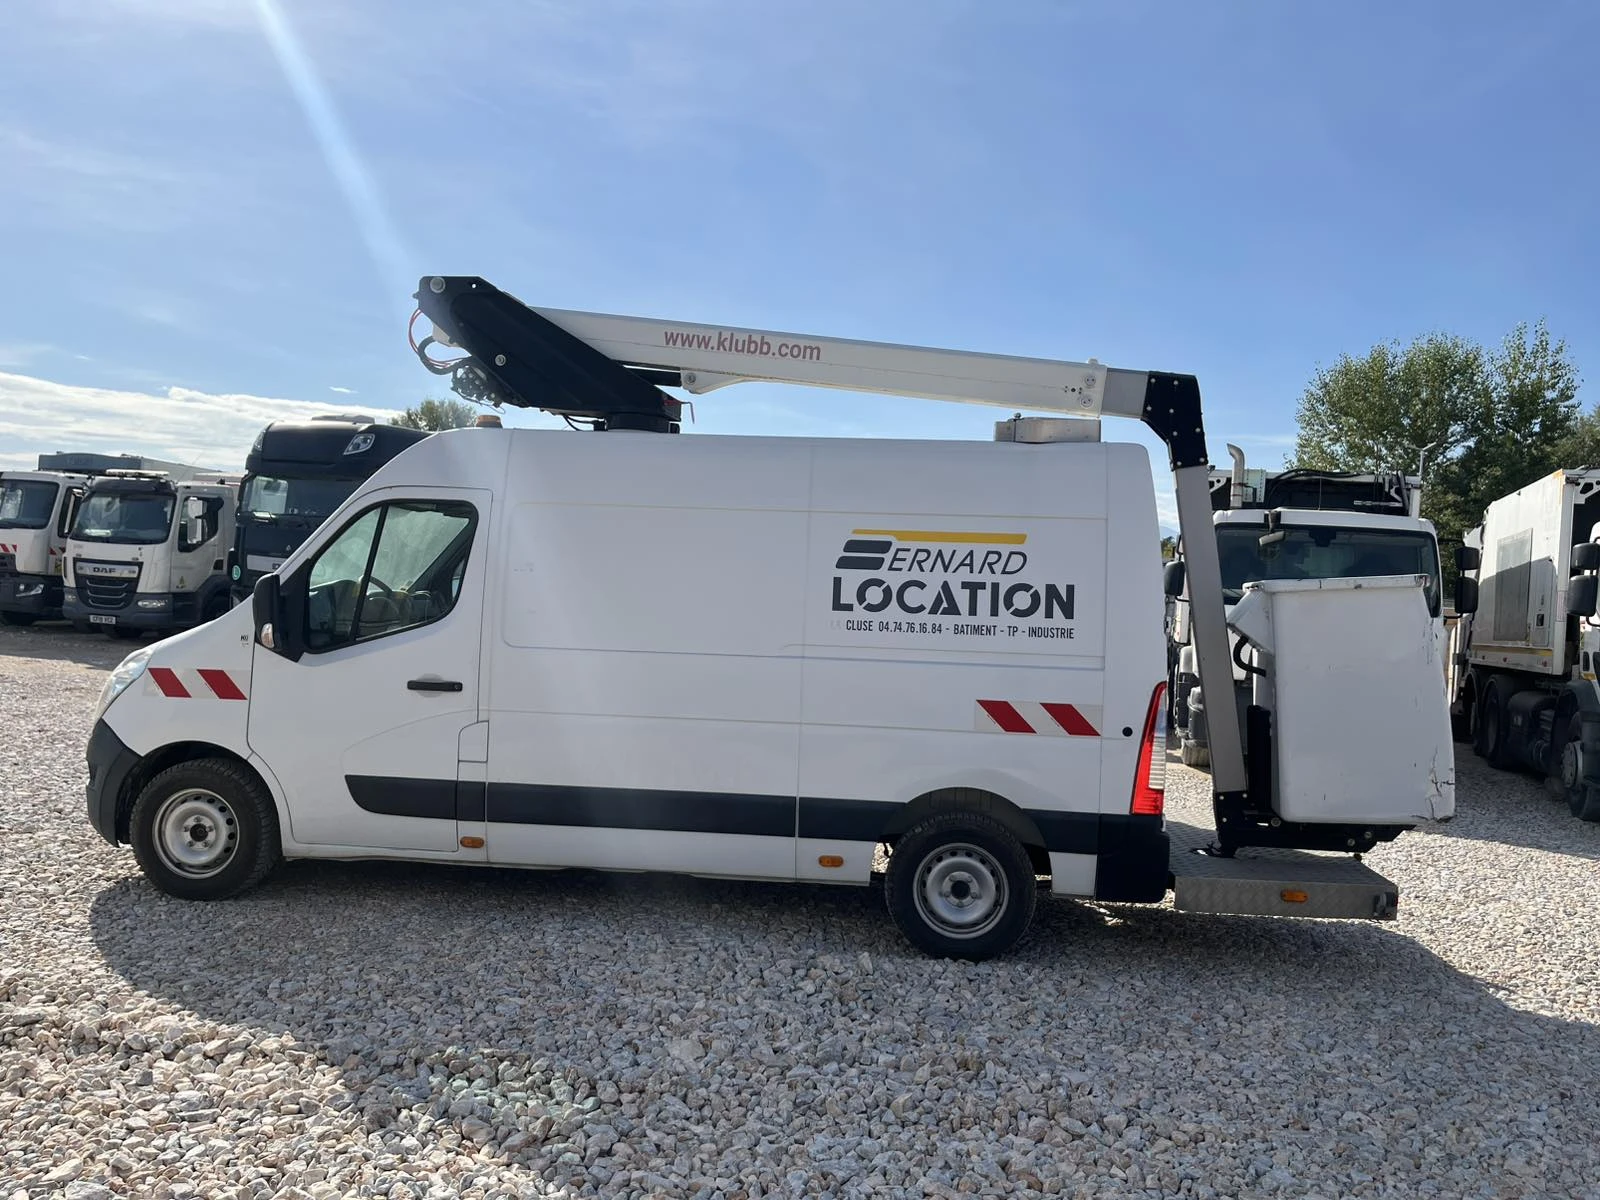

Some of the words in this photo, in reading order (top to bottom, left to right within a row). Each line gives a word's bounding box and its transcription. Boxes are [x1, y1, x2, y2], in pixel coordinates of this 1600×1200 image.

[664, 331, 821, 361] www.klubb.com
[93, 566, 116, 574] DAF
[831, 576, 1075, 620] LOCATION
[846, 619, 873, 632] CLUSE
[878, 620, 942, 634] 04.74.76.16.84
[953, 623, 998, 636] BATIMENT
[1007, 625, 1019, 637] TP
[1028, 626, 1075, 639] INDUSTRIE
